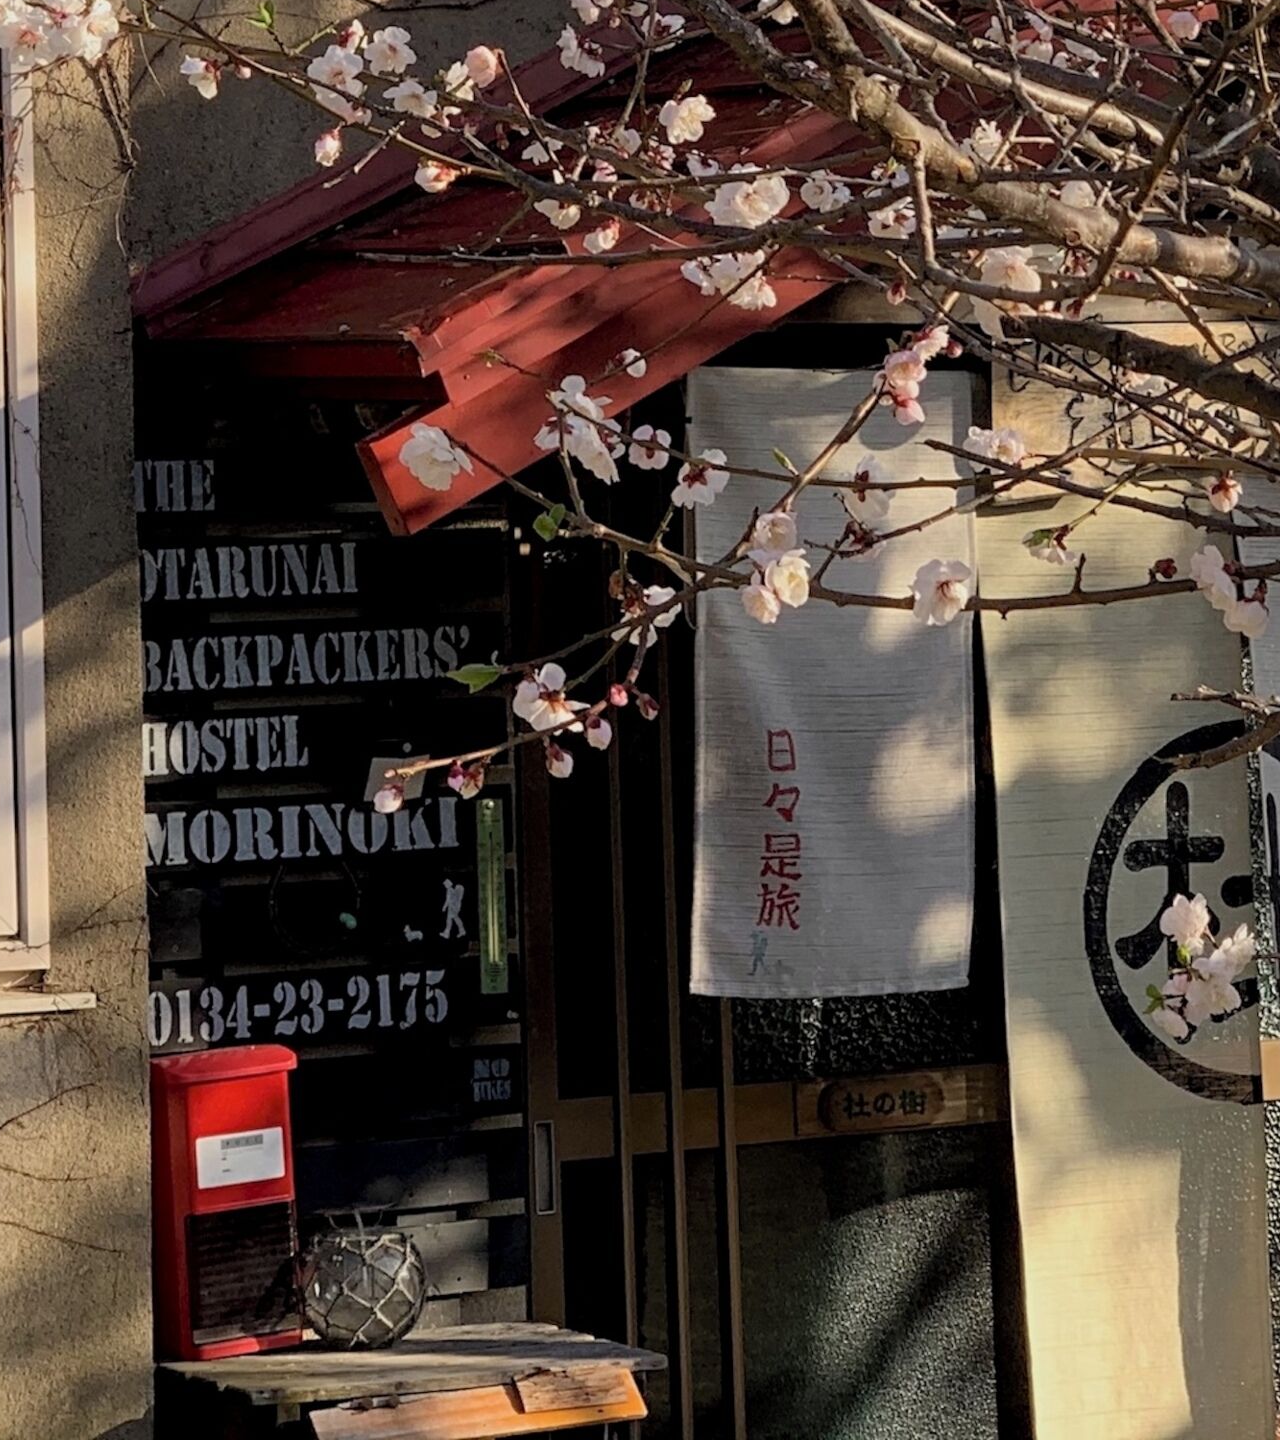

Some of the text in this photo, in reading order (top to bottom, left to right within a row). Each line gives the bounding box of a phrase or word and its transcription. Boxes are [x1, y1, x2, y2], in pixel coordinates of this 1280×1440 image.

[134, 459, 216, 512] THE
[142, 715, 308, 776] HOSTEL
[144, 797, 459, 867] MORINOKI
[757, 729, 801, 931] 日々是旅
[147, 969, 449, 1046] 0134-23-2175
